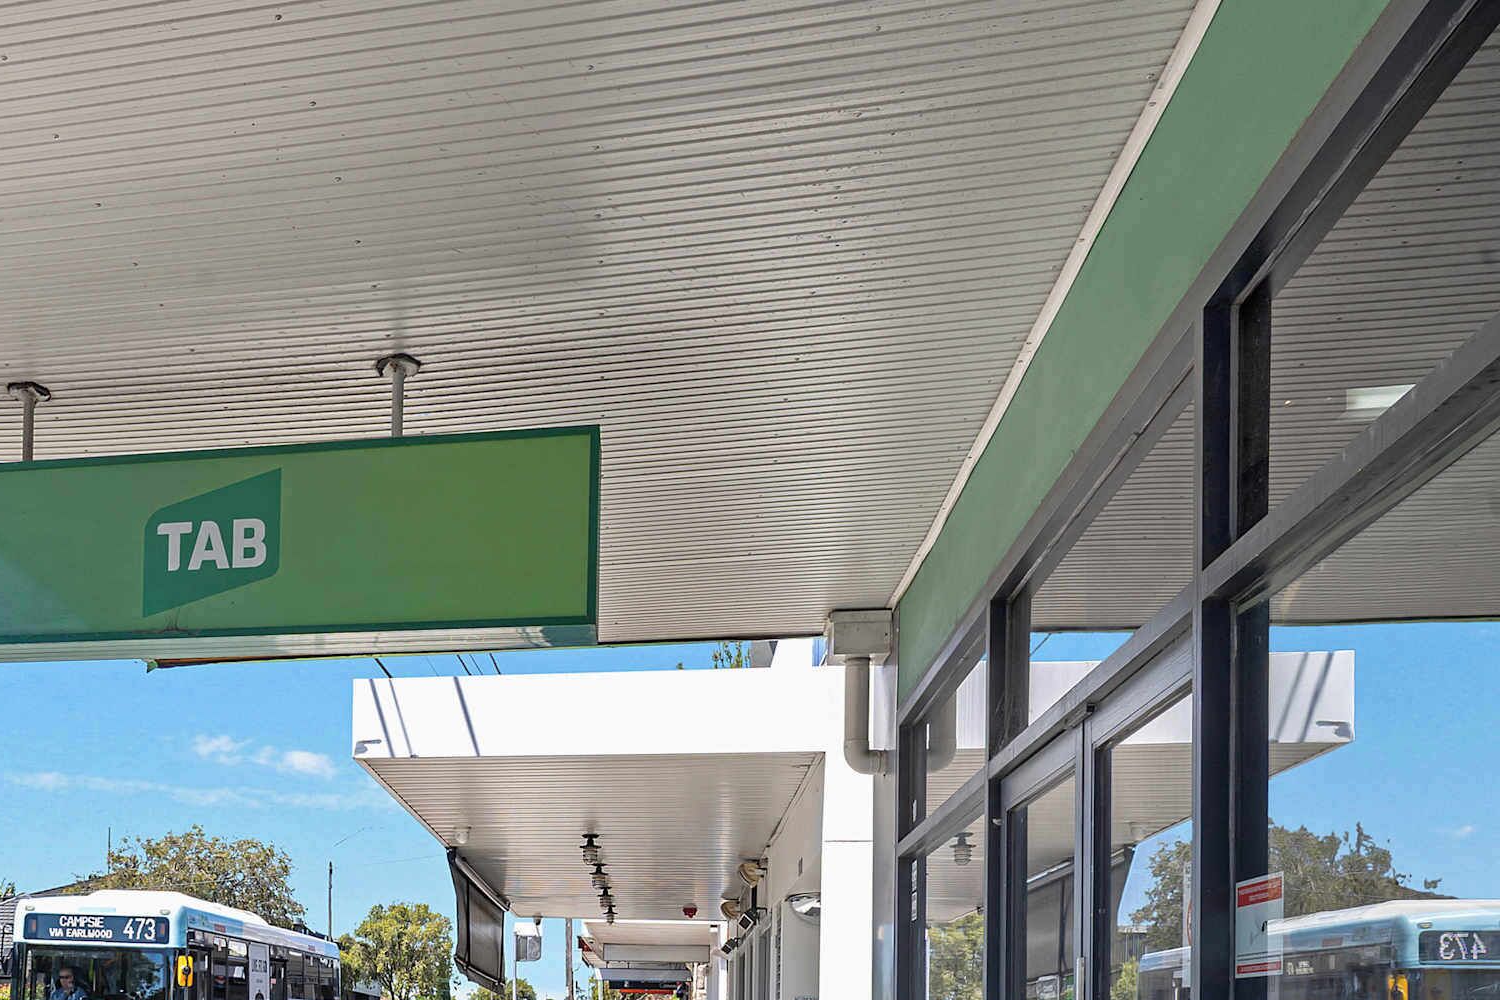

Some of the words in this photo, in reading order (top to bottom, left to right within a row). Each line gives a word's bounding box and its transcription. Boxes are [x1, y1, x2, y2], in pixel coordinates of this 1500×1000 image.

[156, 518, 267, 572] TAB
[59, 915, 104, 928] CAMPSIE
[123, 918, 156, 940] 473
[48, 928, 64, 937] VIA
[66, 929, 113, 939] EARLWOOD
